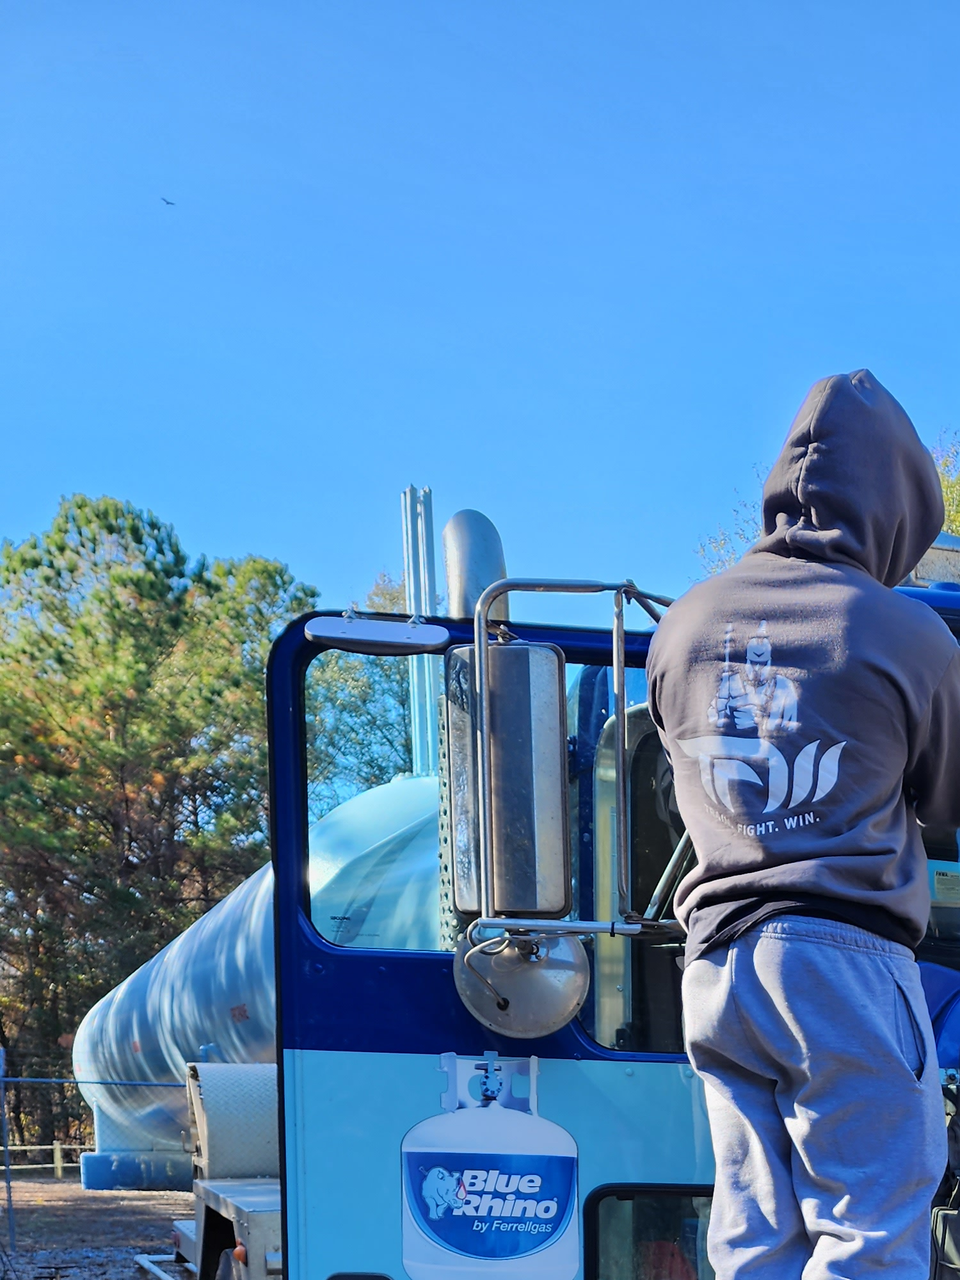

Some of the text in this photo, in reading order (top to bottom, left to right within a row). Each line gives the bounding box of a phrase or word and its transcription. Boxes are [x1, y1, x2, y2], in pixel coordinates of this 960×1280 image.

[737, 821, 779, 837] FIGHT.
[784, 812, 820, 830] WIN.
[461, 1168, 542, 1194] Blue
[452, 1195, 558, 1220] Rhino
[472, 1219, 552, 1233] by Ferrellgas
